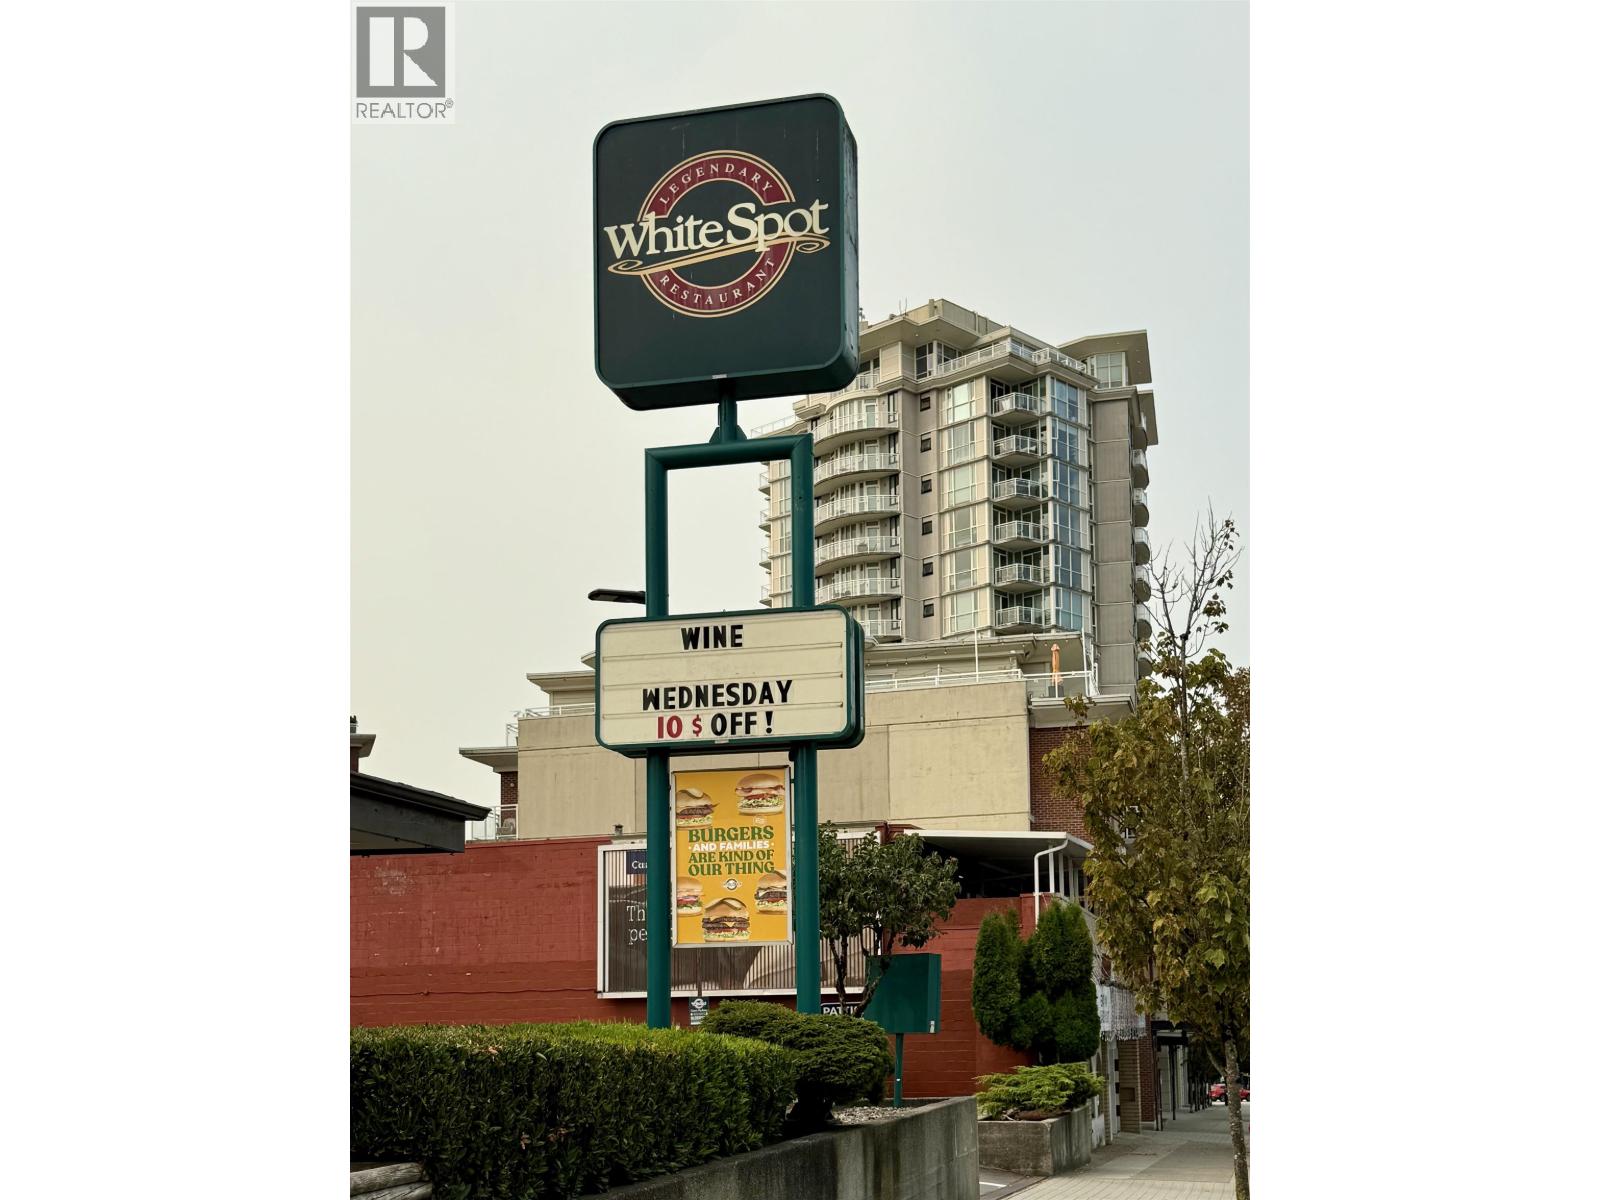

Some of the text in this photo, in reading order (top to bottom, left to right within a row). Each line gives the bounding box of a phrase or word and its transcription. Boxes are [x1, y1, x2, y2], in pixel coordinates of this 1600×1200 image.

[659, 163, 774, 205] LEGENDARY
[603, 198, 830, 260] White Spot
[659, 259, 775, 305] RESTAURANT
[681, 624, 744, 650] WINE
[642, 679, 793, 711] WEDNESDAY
[688, 825, 775, 843] BURGERS
[692, 840, 770, 852] AND FAMILIES
[688, 849, 775, 864] ARE KIND OF
[688, 861, 775, 877] OUR THING
[626, 905, 646, 922] Th
[628, 927, 648, 945] pe
